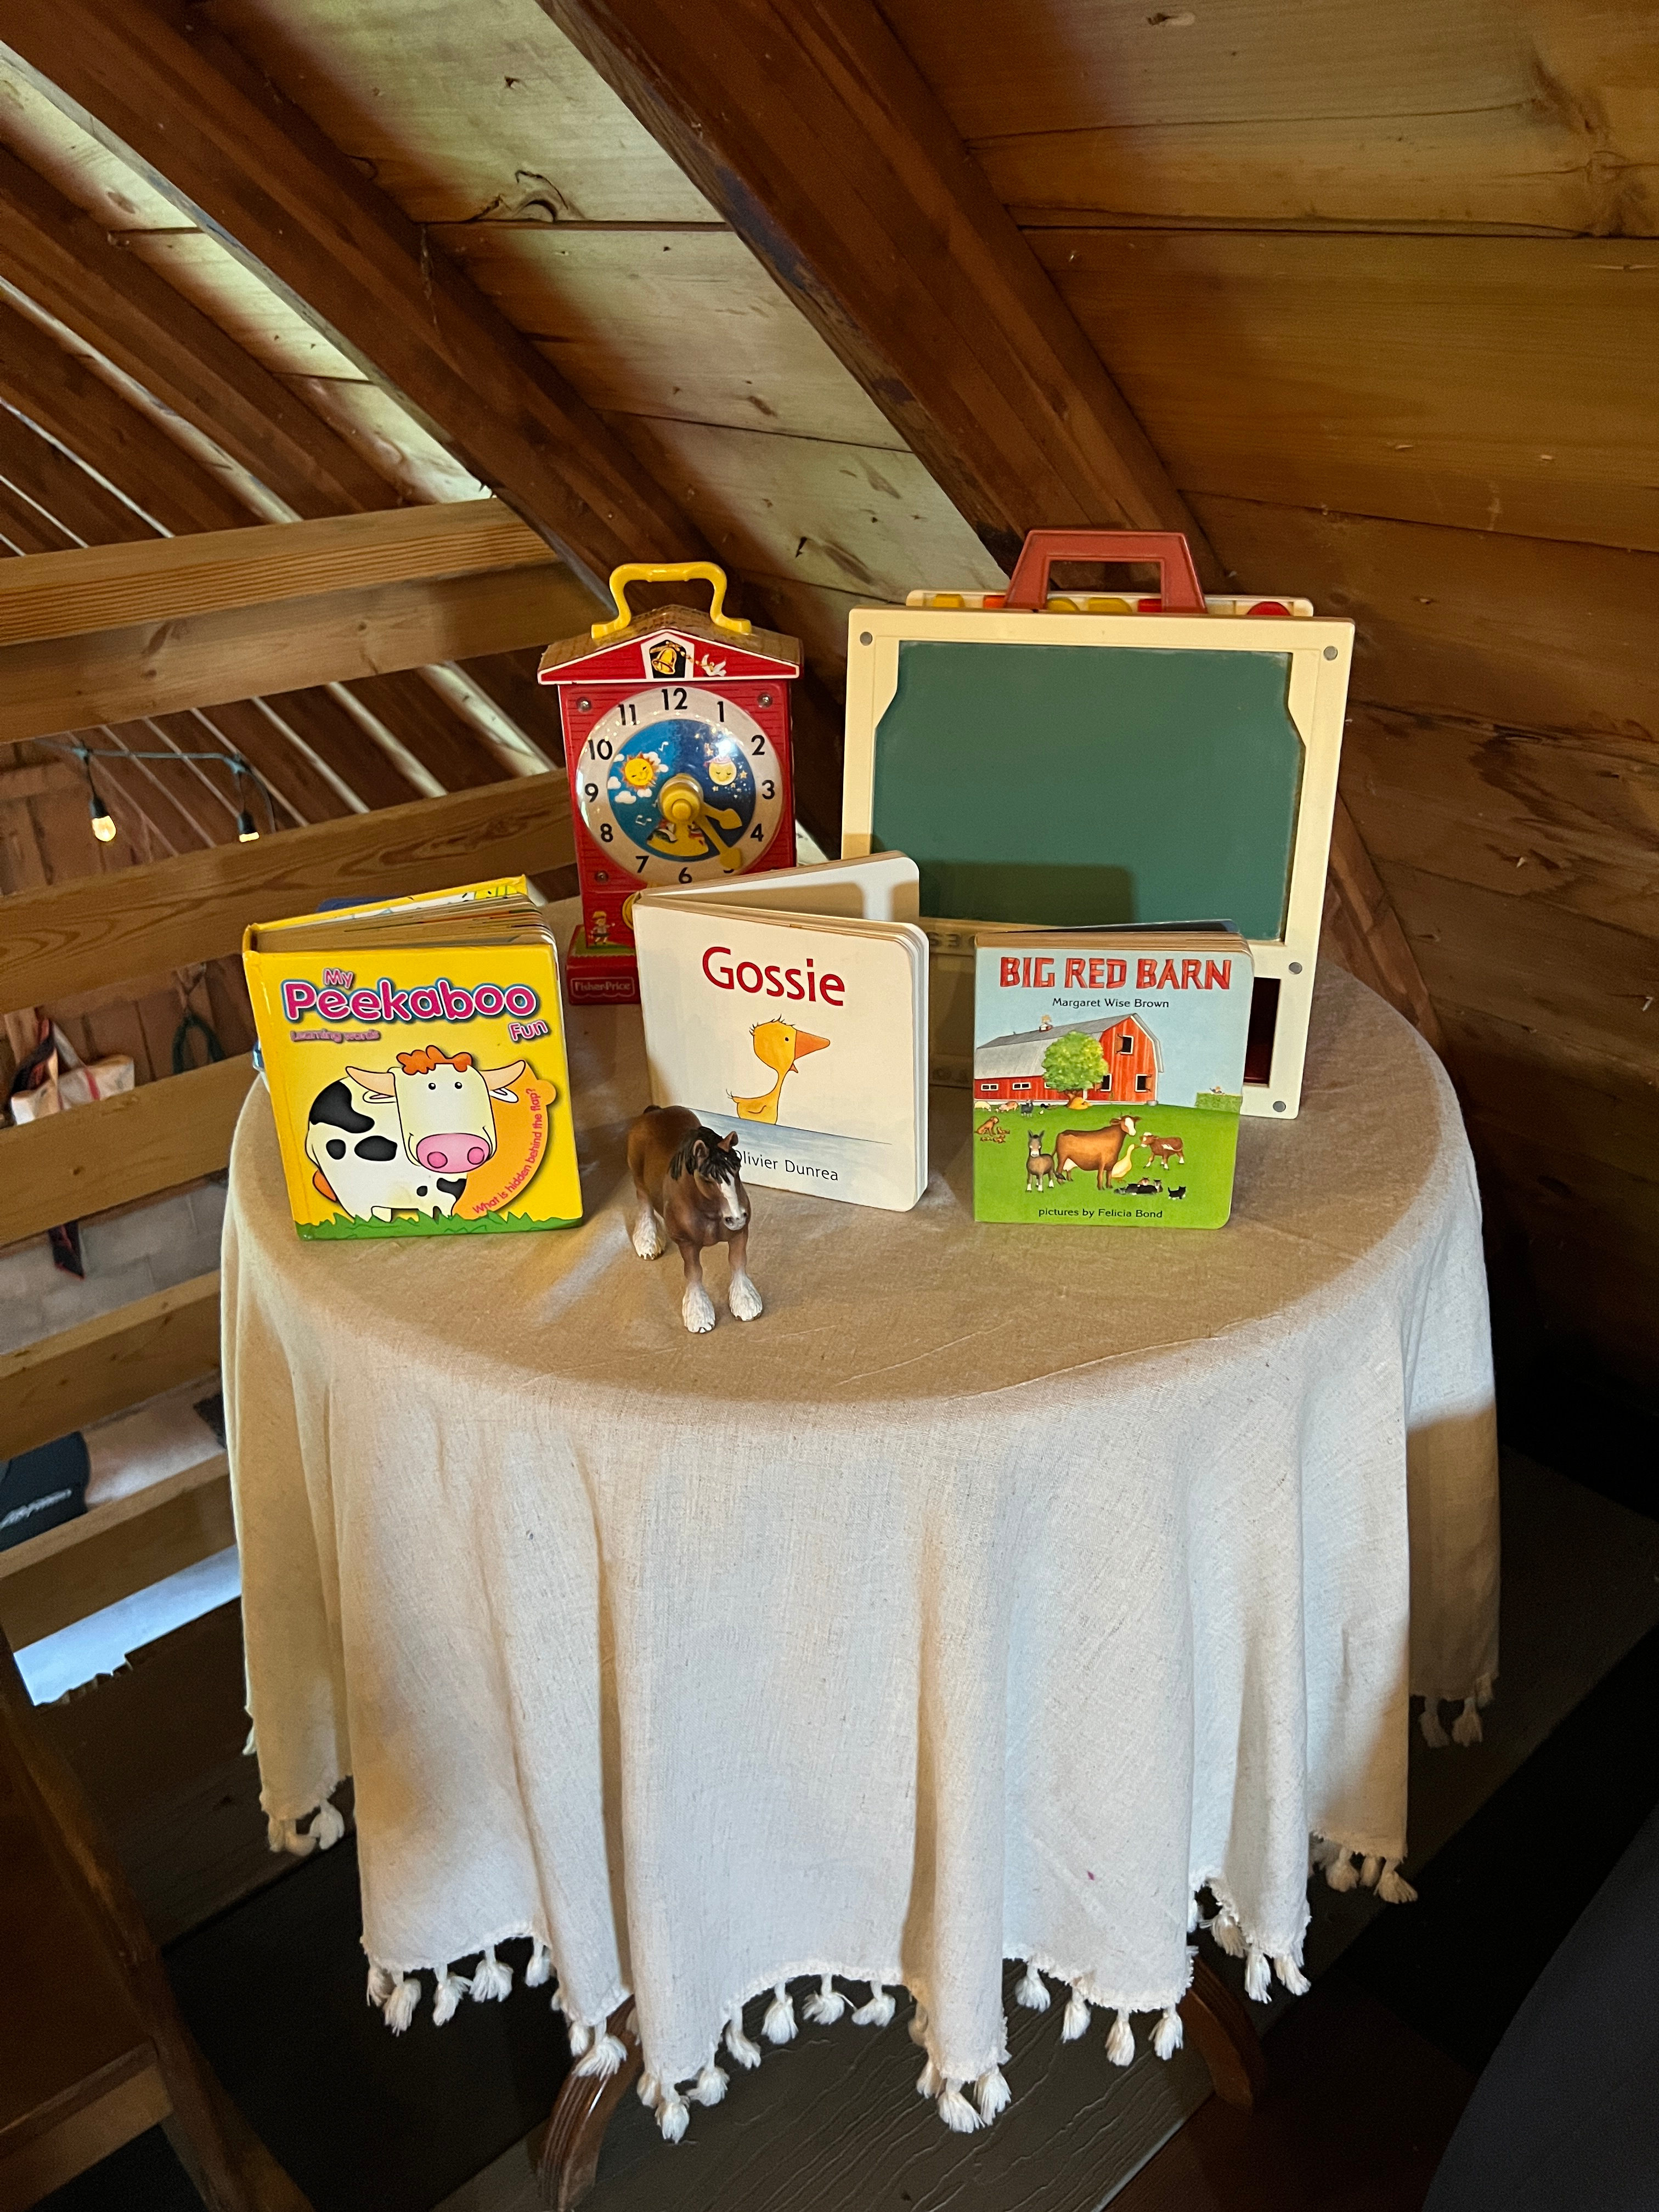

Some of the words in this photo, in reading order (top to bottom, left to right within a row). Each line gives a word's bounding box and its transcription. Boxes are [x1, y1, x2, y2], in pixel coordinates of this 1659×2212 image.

[662, 688, 688, 710] 12
[618, 704, 637, 726] 11
[716, 701, 725, 722] 1
[588, 738, 613, 760] 10
[751, 735, 765, 755] 2
[584, 783, 599, 803] 9
[761, 780, 775, 800] 3
[600, 823, 613, 842] 8
[750, 823, 764, 842] 4
[635, 855, 650, 873] 7
[678, 867, 693, 884] 6
[323, 968, 354, 989] My
[702, 946, 845, 1007] Gossie
[1000, 957, 1056, 988] BIG
[1064, 957, 1127, 989] RED
[1136, 958, 1232, 990] BARN
[574, 981, 631, 991] Fisher-Price
[283, 978, 537, 1022] Peekaboo
[1052, 998, 1101, 1009] Margaret
[1104, 998, 1130, 1008] Wise
[1135, 998, 1170, 1008] Brown
[509, 1020, 549, 1042] Fun
[525, 1087, 541, 1111] flap?
[532, 1113, 543, 1129] the
[525, 1131, 542, 1164] behind
[505, 1164, 532, 1193] hidden
[785, 1159, 839, 1181] Dunrea
[472, 1196, 500, 1214] What
[497, 1191, 509, 1200] is
[1038, 1209, 1079, 1217] pictures
[1082, 1208, 1095, 1218] by
[1098, 1209, 1132, 1217] Felicia
[1136, 1209, 1163, 1218] Bond
